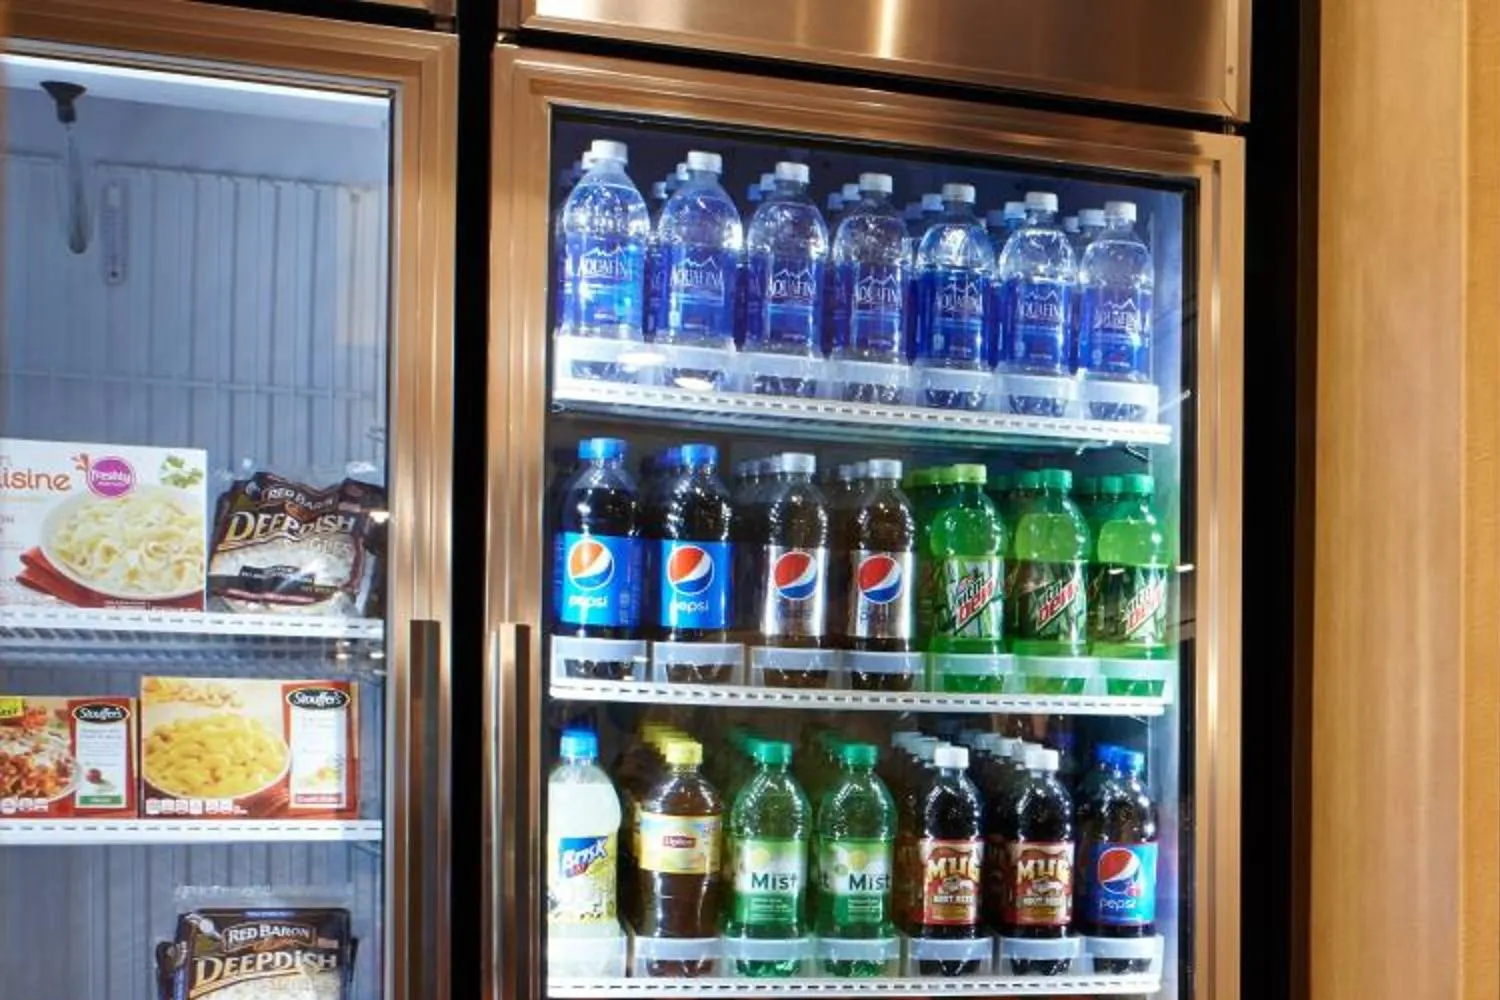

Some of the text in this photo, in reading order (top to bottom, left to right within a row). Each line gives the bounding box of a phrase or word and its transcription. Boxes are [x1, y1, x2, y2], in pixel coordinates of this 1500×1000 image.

[0, 467, 72, 492] isine
[670, 599, 710, 613] pepsi
[292, 690, 342, 708] Stouffer's
[79, 705, 123, 722] Stouffer's
[927, 857, 980, 882] MUG
[1016, 858, 1071, 882] MUG
[751, 871, 798, 890] Mist
[848, 872, 891, 892] Mist
[228, 923, 310, 944] RED BARON
[193, 949, 337, 983] DEEP DISH
